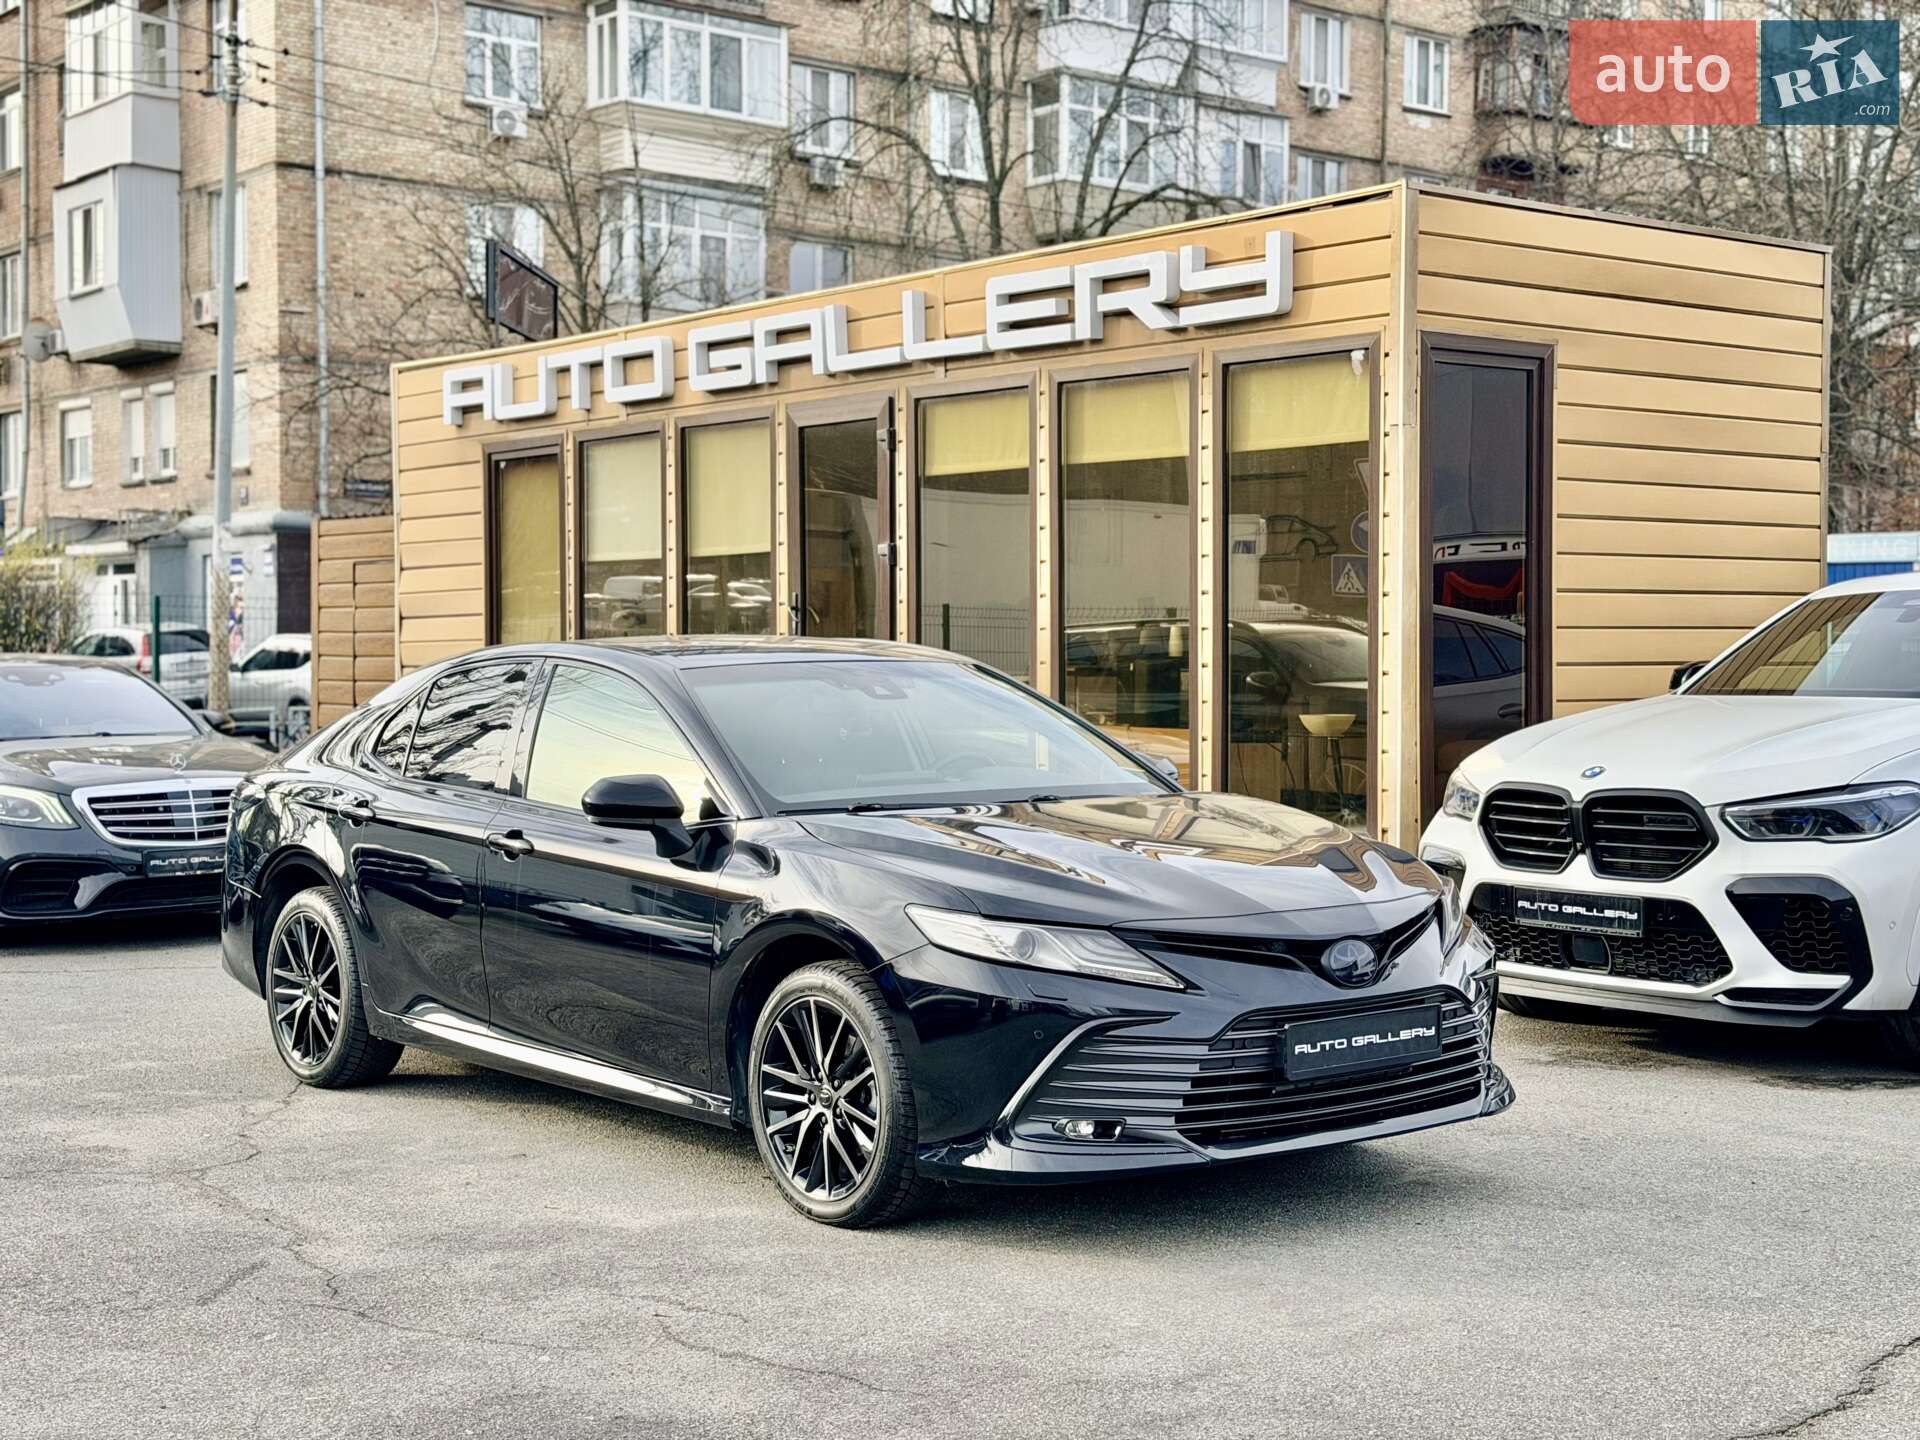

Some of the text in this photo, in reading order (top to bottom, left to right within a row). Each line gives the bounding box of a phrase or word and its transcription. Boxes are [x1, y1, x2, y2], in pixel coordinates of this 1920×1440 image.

[442, 230, 1294, 426] AUTO GALLERY
[150, 855, 227, 866] AUTO GALL
[1517, 900, 1638, 920] AUTO GALLERY
[1294, 1026, 1436, 1055] AUTO GALLERY
